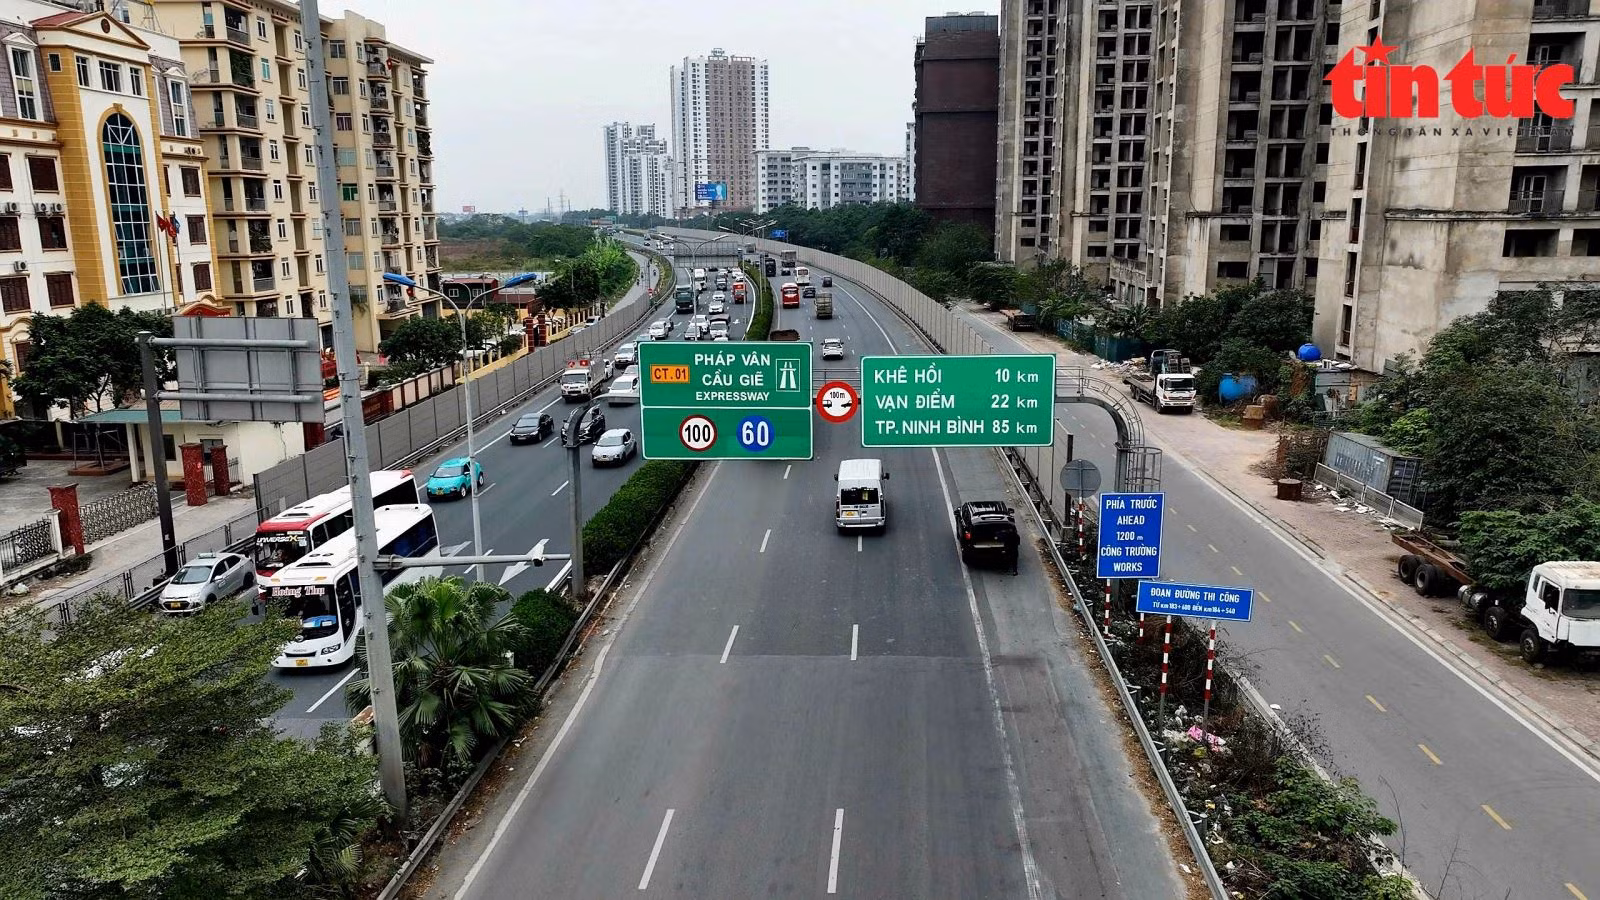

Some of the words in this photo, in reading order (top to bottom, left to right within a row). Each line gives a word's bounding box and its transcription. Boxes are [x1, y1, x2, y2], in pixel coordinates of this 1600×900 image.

[694, 350, 735, 366] PHÁP
[741, 350, 771, 366] VÂN
[653, 368, 687, 380] CT.01
[702, 369, 732, 386] CẦU
[739, 371, 764, 386] GIẼ
[874, 366, 908, 384] KHÊ
[914, 362, 942, 384] HỒI
[995, 368, 1010, 383] 10
[1016, 371, 1039, 383] km
[695, 391, 770, 401] EXPRESSWAY
[875, 395, 908, 412] VẠN
[915, 388, 955, 409] ĐIỂM
[991, 394, 1009, 409] 22
[1016, 396, 1038, 409] km
[684, 424, 711, 443] 100
[741, 420, 769, 447] 60
[875, 420, 899, 435] TP.
[902, 420, 941, 434] NINH
[946, 416, 985, 434] BÌNH
[992, 419, 1010, 434] 85
[1016, 422, 1037, 434] km
[1105, 497, 1126, 510] PHÍA
[1130, 496, 1158, 509] TRƯỚC
[1116, 515, 1146, 525] AHEAD
[1116, 531, 1136, 541] 1200
[1100, 545, 1123, 557] CÔNG
[1124, 543, 1158, 557] TRƯỜNG
[1113, 562, 1143, 572] WORKS
[1174, 588, 1201, 600] ĐƯỜNG
[1203, 591, 1216, 601] THI
[1219, 592, 1241, 604] CÔNG
